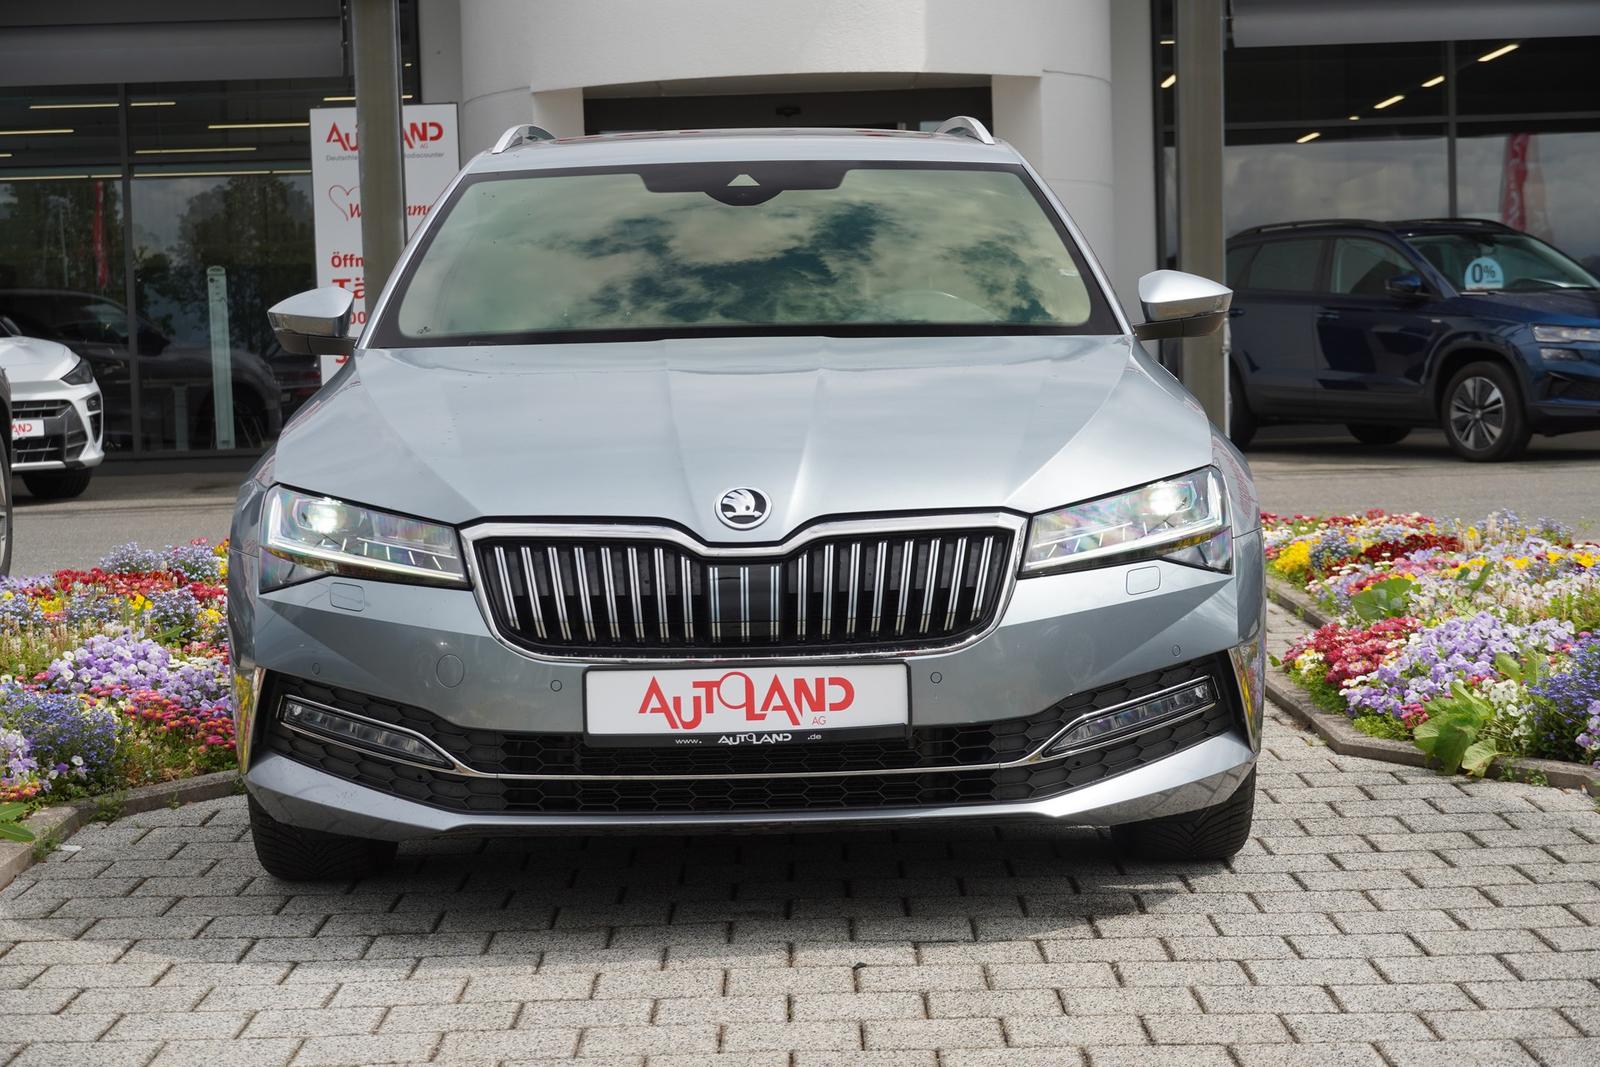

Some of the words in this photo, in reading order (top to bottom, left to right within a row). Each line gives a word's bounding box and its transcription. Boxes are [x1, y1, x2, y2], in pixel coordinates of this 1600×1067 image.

[331, 251, 364, 268] Öffn
[1472, 263, 1496, 283] 0%
[638, 671, 855, 730] AUTOLAND
[811, 715, 827, 726] AG
